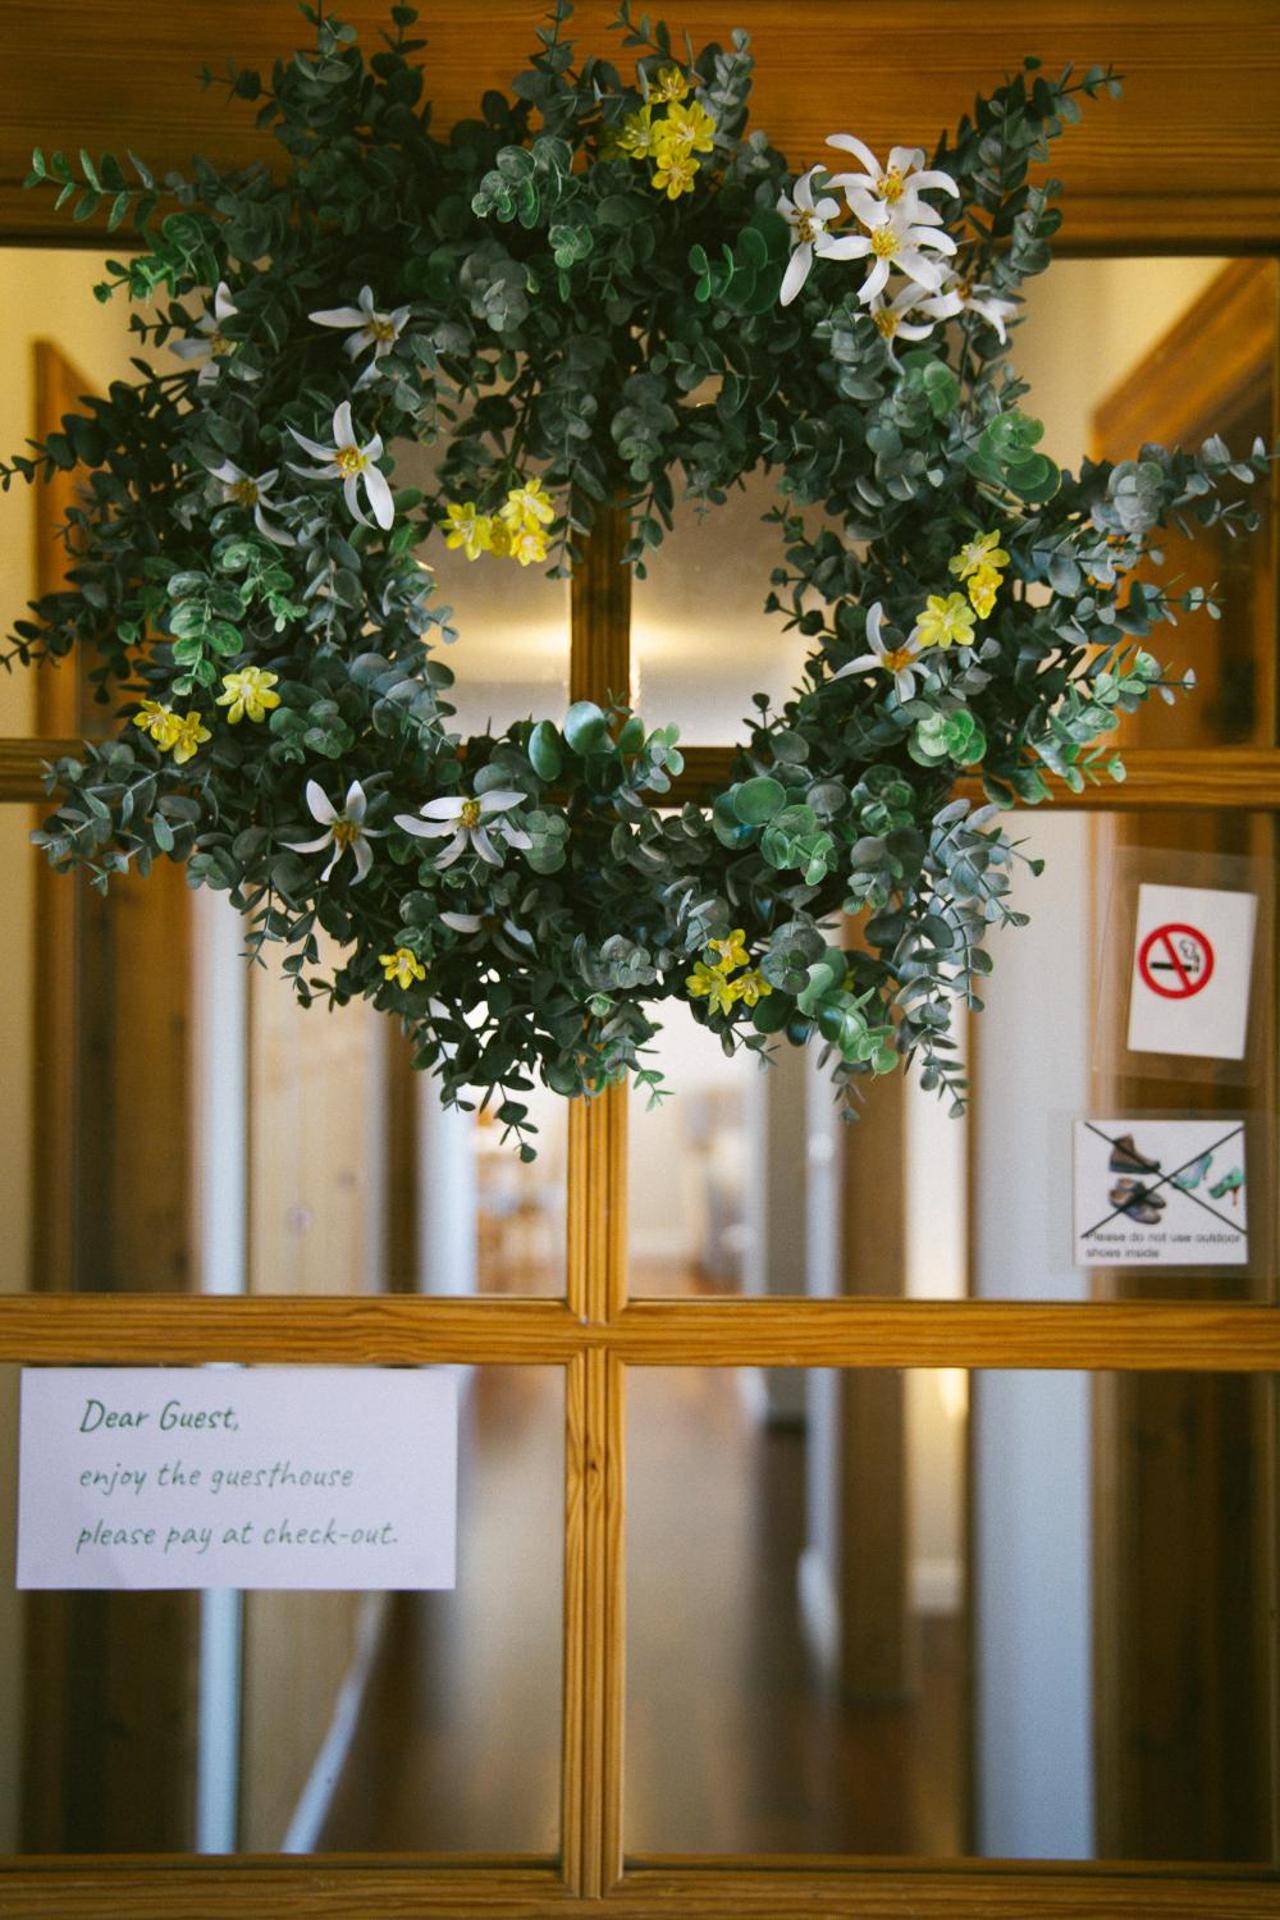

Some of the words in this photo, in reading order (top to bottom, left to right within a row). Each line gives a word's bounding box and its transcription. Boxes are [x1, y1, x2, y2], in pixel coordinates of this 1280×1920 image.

[1087, 1248, 1121, 1258] shoes
[1124, 1248, 1160, 1258] inside
[1130, 1232, 1144, 1243] do
[1147, 1232, 1168, 1243] not
[1170, 1234, 1192, 1243] use
[1195, 1232, 1241, 1244] outdoor
[79, 1398, 149, 1433] Dear
[159, 1400, 240, 1431] Guest,
[79, 1463, 146, 1495] enjoy
[157, 1460, 201, 1486] the
[211, 1460, 354, 1494] guesthouse
[76, 1522, 156, 1554] please
[164, 1526, 213, 1554] pay
[222, 1521, 253, 1545] at
[263, 1518, 399, 1546] check-out.
